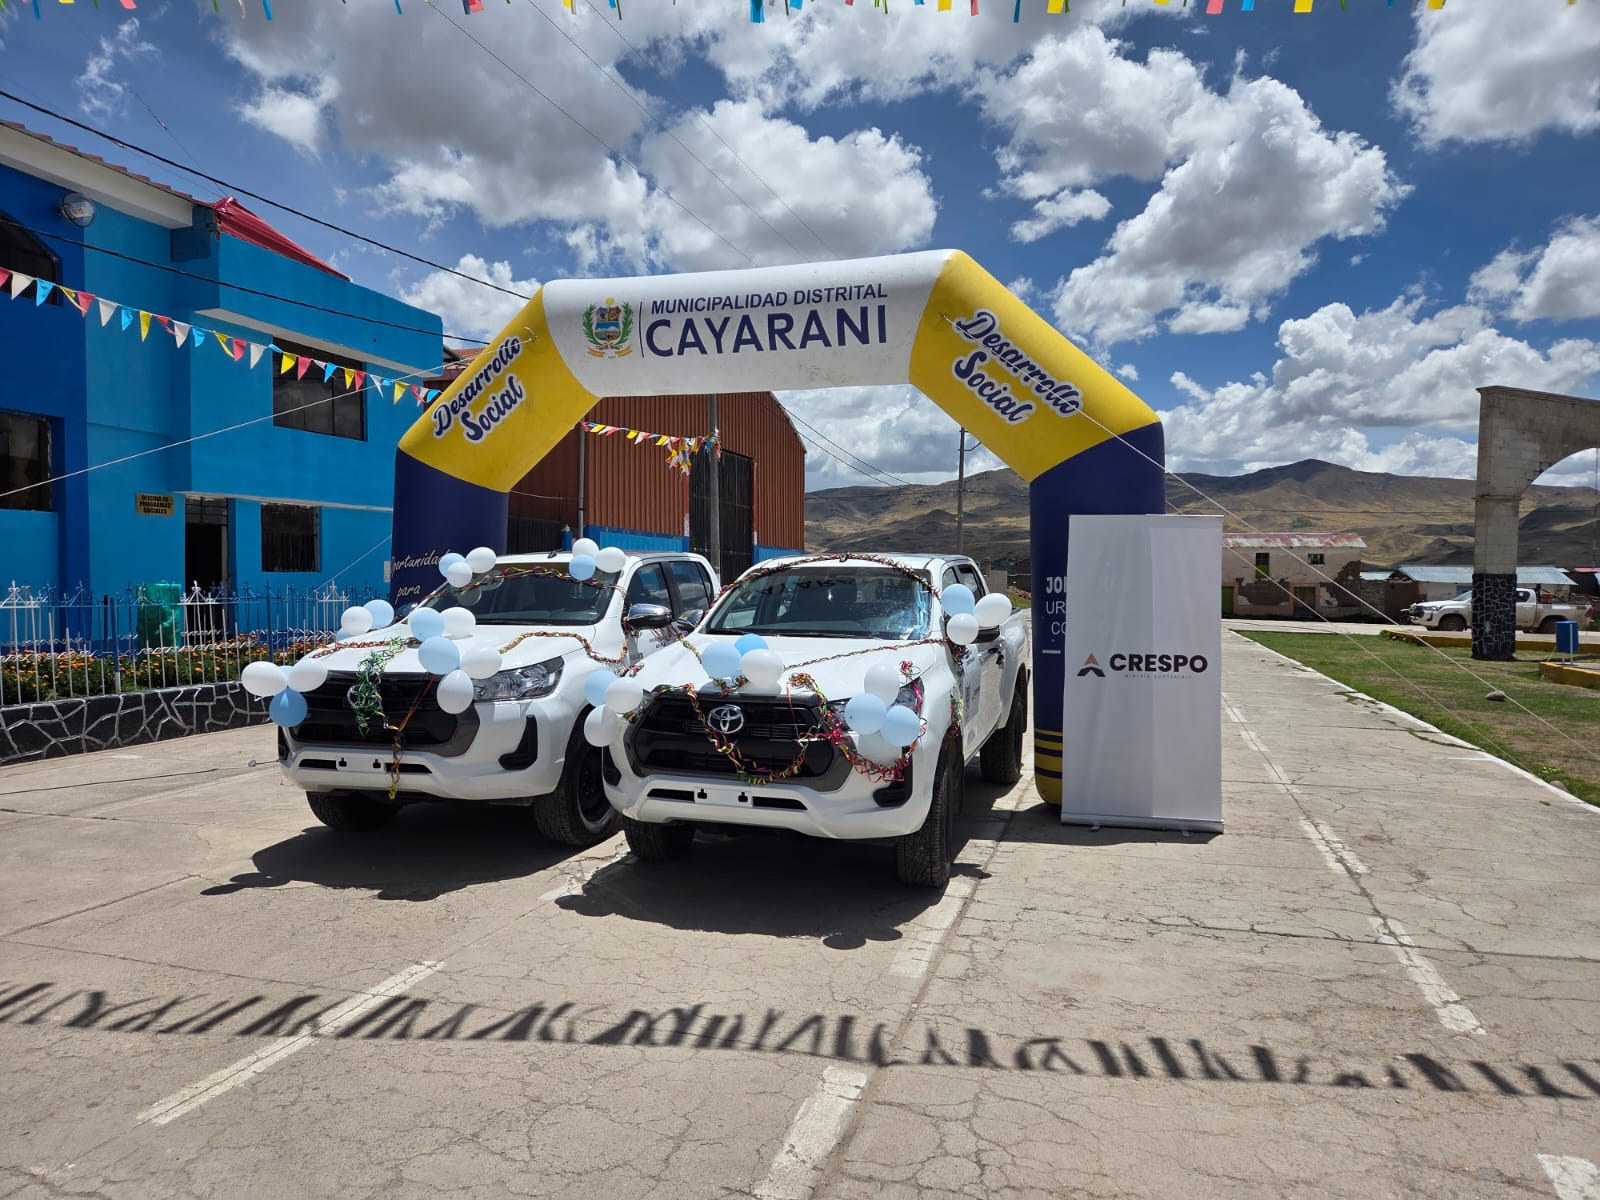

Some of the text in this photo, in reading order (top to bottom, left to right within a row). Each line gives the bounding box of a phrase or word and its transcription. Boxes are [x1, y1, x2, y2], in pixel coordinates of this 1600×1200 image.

[651, 283, 888, 314] MUNICIPALIDAD DISTRITAL
[645, 304, 887, 357] CAYARANI
[432, 335, 522, 437] Desarrollo
[954, 310, 1081, 414] Desarrollo
[954, 350, 1034, 422] Social
[459, 375, 524, 441] Social
[394, 585, 421, 605] para
[1109, 653, 1208, 673] CRESPO
